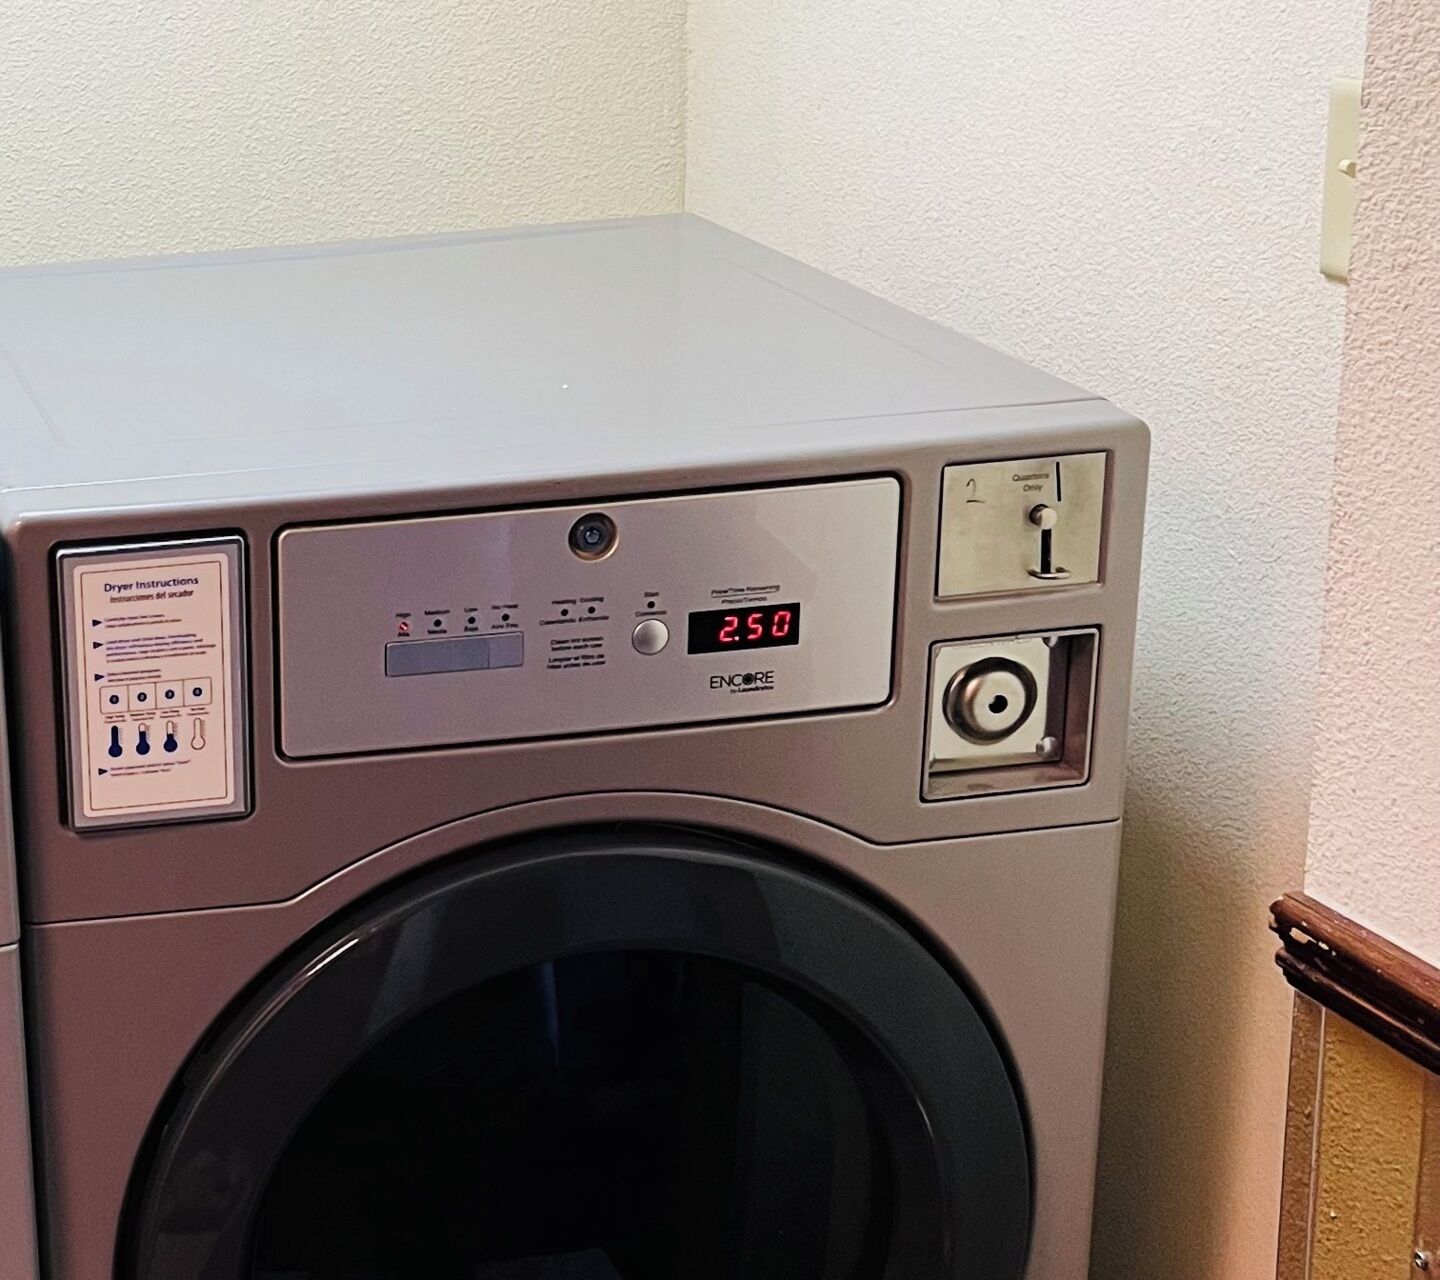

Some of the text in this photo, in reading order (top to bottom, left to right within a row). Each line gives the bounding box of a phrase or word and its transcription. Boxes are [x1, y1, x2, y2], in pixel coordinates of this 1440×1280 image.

[1023, 484, 1044, 492] Only
[104, 577, 199, 594] Dryer Instructions
[720, 611, 791, 642] 2.50
[709, 670, 775, 689] ENCORE
